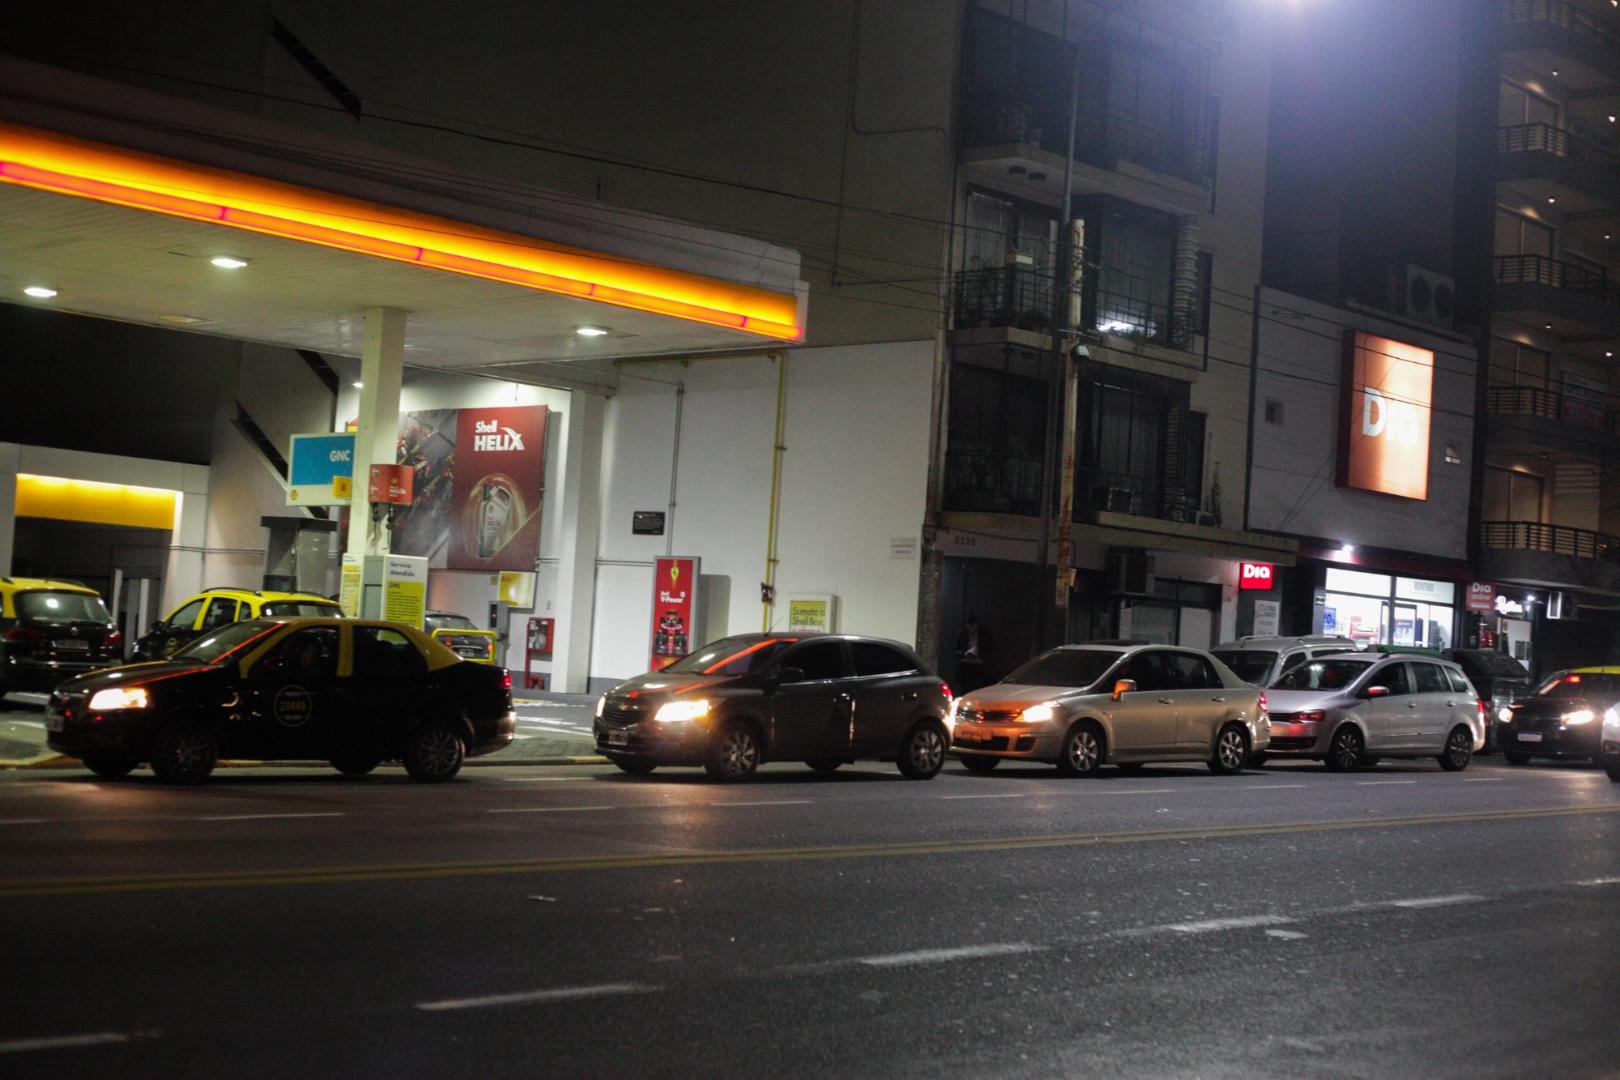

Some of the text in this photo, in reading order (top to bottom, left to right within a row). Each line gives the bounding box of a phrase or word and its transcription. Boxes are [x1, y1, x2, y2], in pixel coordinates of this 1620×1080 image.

[475, 420, 498, 433] Shell
[474, 427, 525, 451] HELIX
[329, 450, 351, 462] GNC
[1243, 563, 1271, 579] Dia
[1472, 582, 1492, 593] Dia
